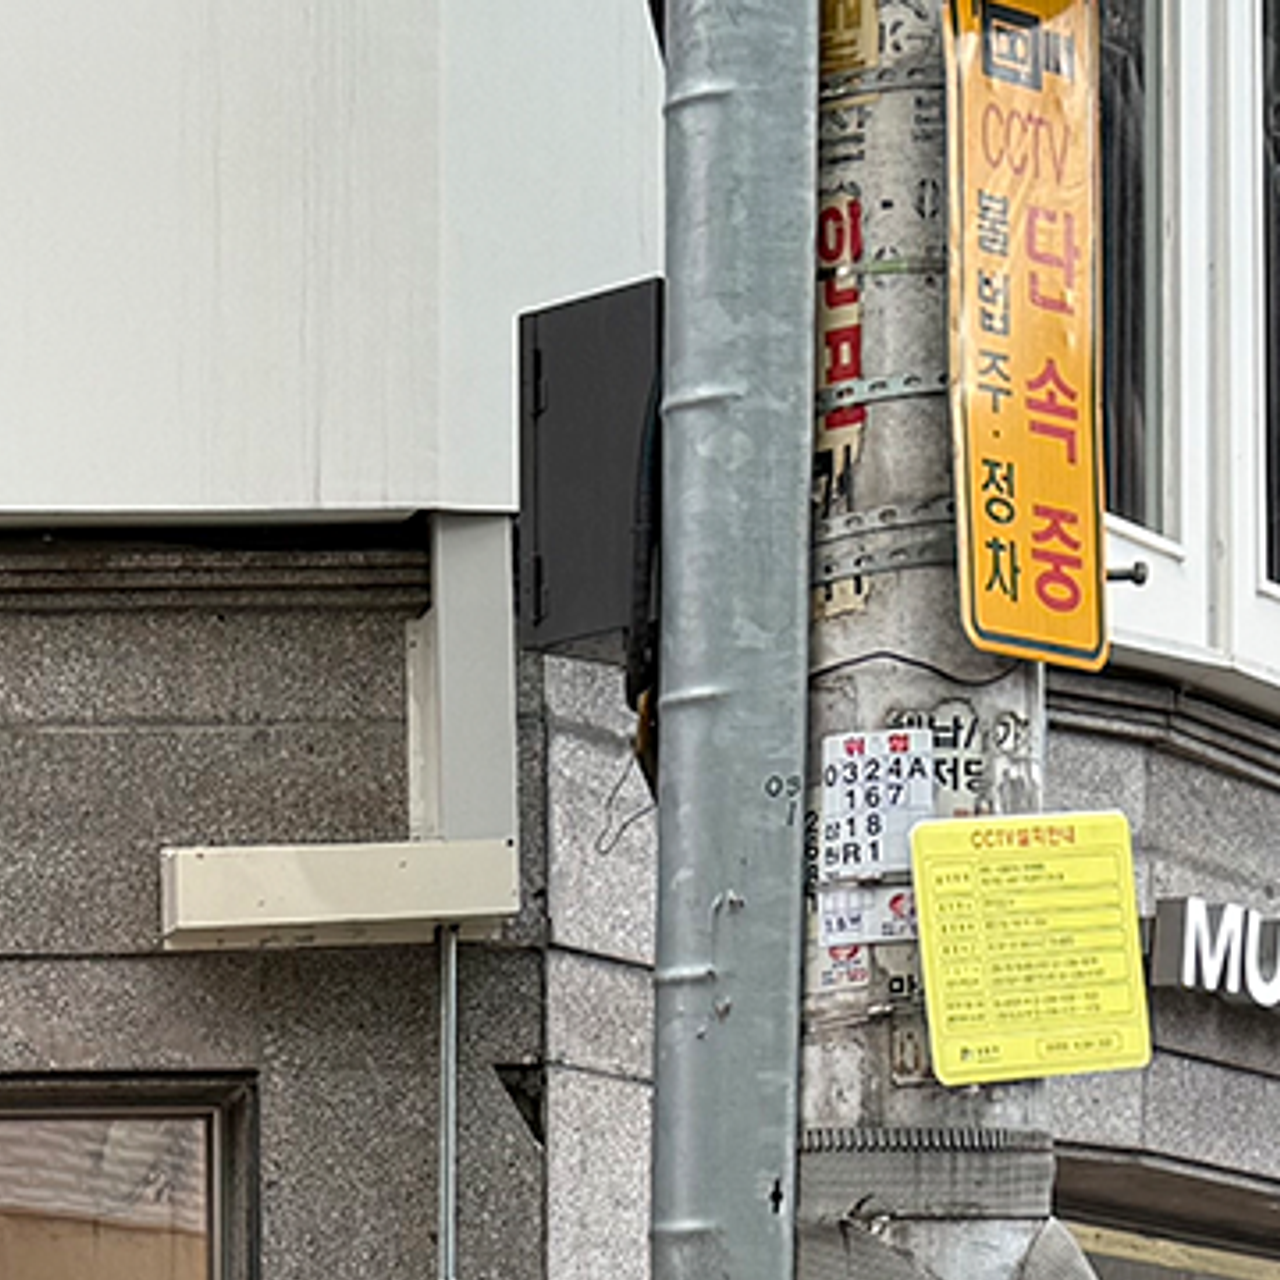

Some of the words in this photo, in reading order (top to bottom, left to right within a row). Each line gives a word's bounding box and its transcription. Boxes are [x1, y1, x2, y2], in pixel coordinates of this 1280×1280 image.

[981, 103, 1072, 186] CCTV
[825, 756, 928, 788] 0324A
[844, 783, 904, 808] 167
